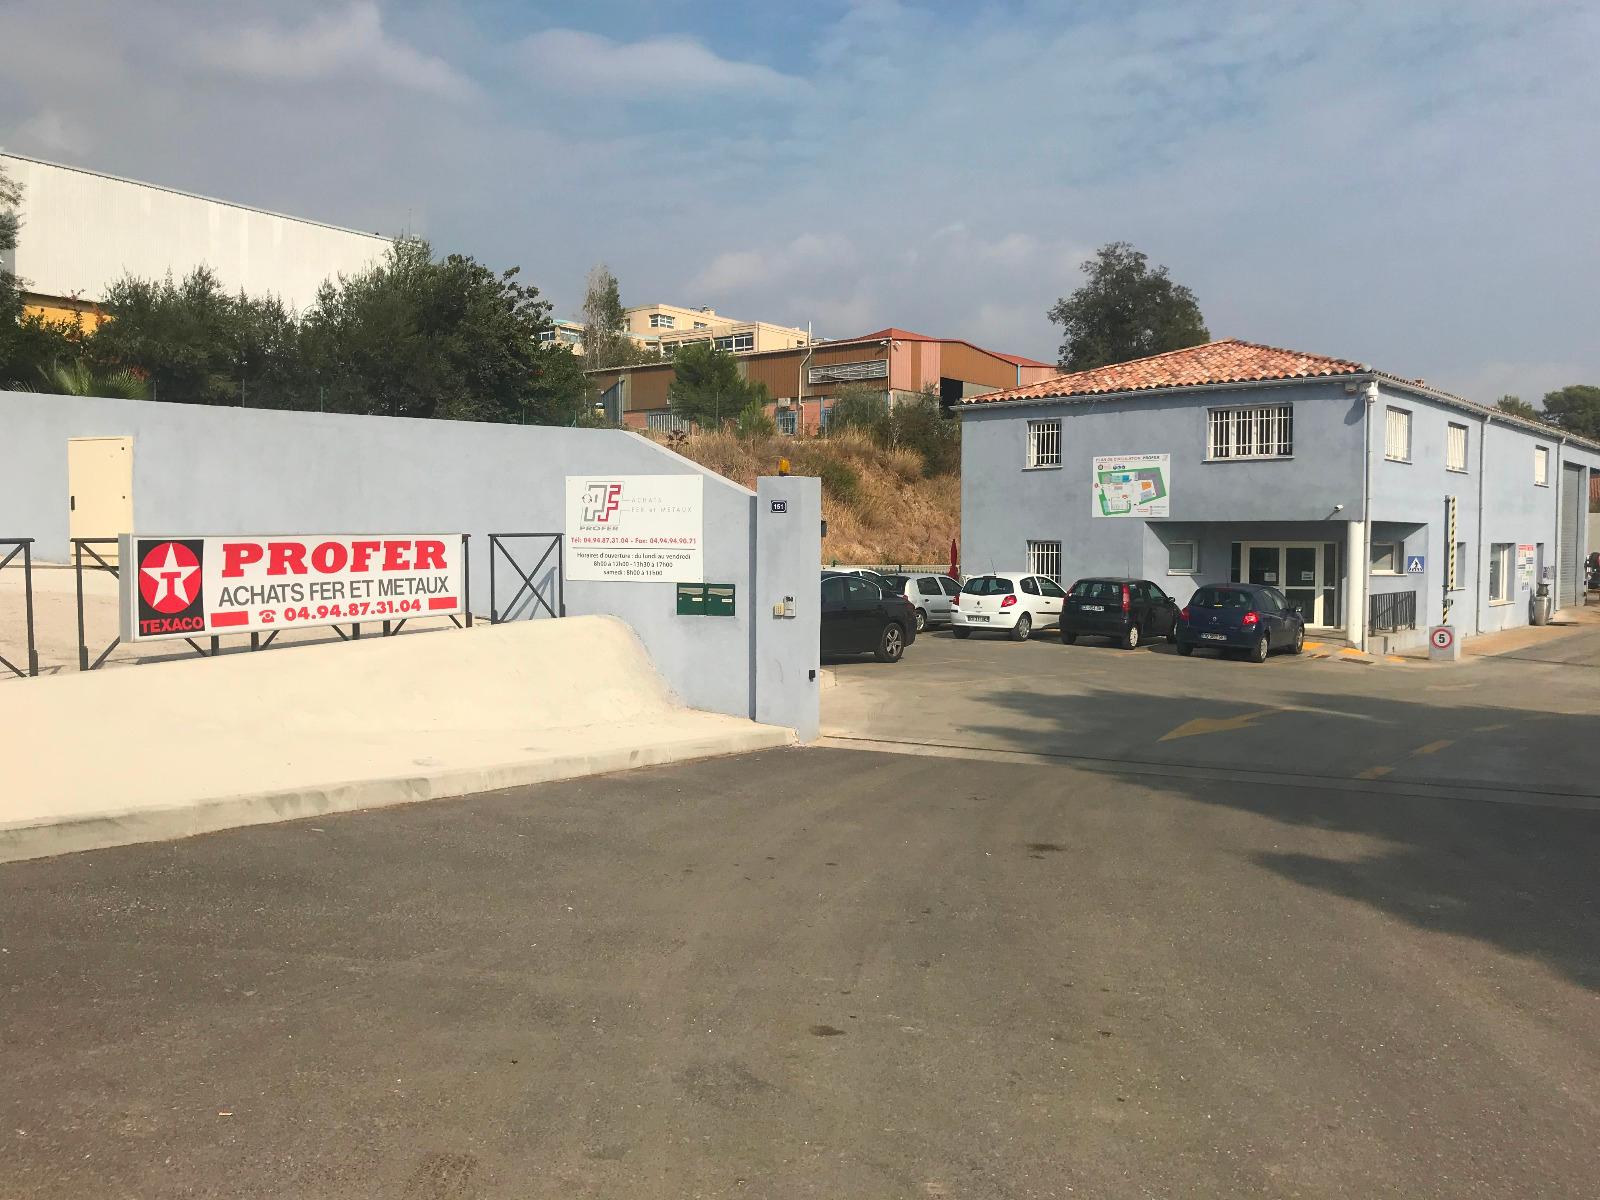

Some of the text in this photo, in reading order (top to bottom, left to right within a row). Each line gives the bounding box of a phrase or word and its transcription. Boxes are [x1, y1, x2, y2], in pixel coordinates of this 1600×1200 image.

[222, 540, 447, 577] PROFER
[218, 576, 449, 607] ACHATS FER ET METAUX
[284, 599, 421, 621] 04.94.87.31.04
[140, 616, 204, 634] TEXACO
[1438, 634, 1446, 644] 5
